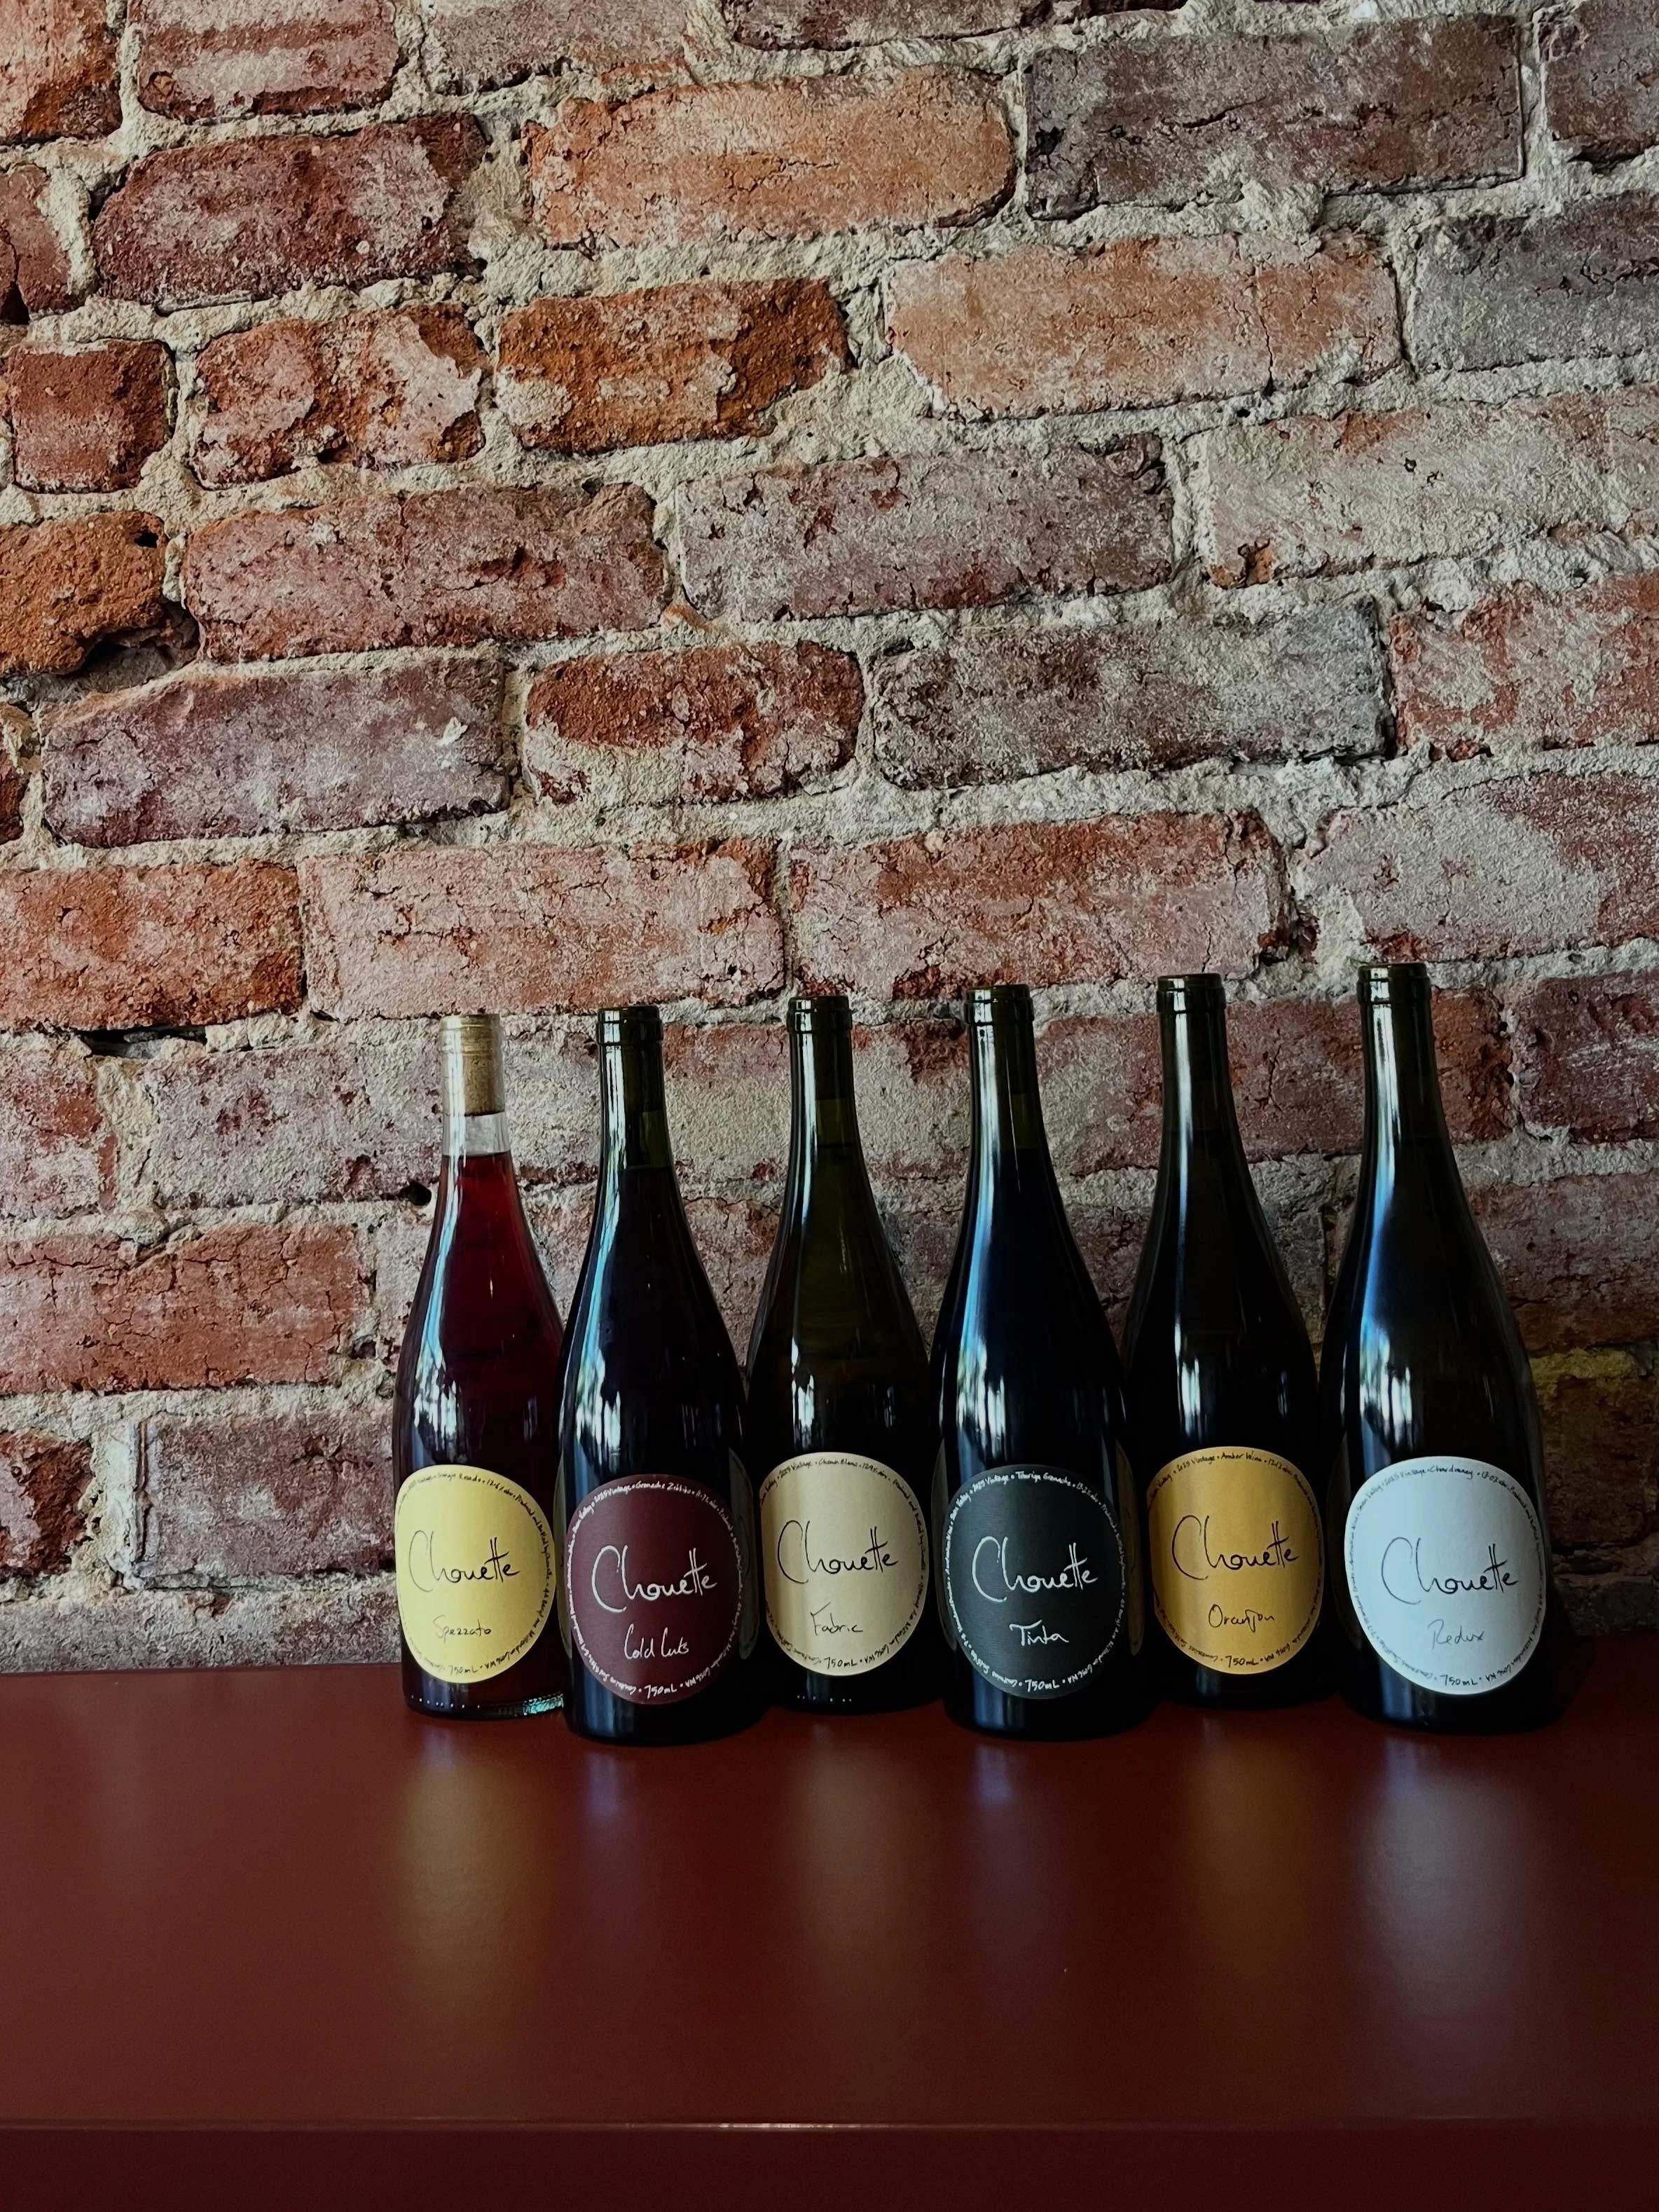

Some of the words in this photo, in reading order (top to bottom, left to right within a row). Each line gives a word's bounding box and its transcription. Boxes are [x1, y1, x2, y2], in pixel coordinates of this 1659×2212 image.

[1220, 1451, 1245, 1460] Amber
[408, 1530, 521, 1593] Chouette
[777, 1520, 900, 1584] Chouette
[1171, 1515, 1300, 1580] Chouette
[591, 1545, 717, 1613] Chouette
[972, 1536, 1099, 1602] Chouette
[1381, 1537, 1519, 1605] Chouette
[432, 1614, 492, 1643] Spezzato
[810, 1601, 864, 1636] Fabric
[1009, 1619, 1071, 1647] Tinta
[624, 1623, 656, 1660] Cold
[661, 1626, 689, 1657] Cuts
[1427, 1619, 1485, 1649] Redux
[822, 1656, 858, 1670] 750mL
[1225, 1654, 1260, 1668] 750mL
[644, 1683, 677, 1699] 750mL
[1024, 1679, 1060, 1693] 750mL
[1440, 1674, 1478, 1687] 750mL
